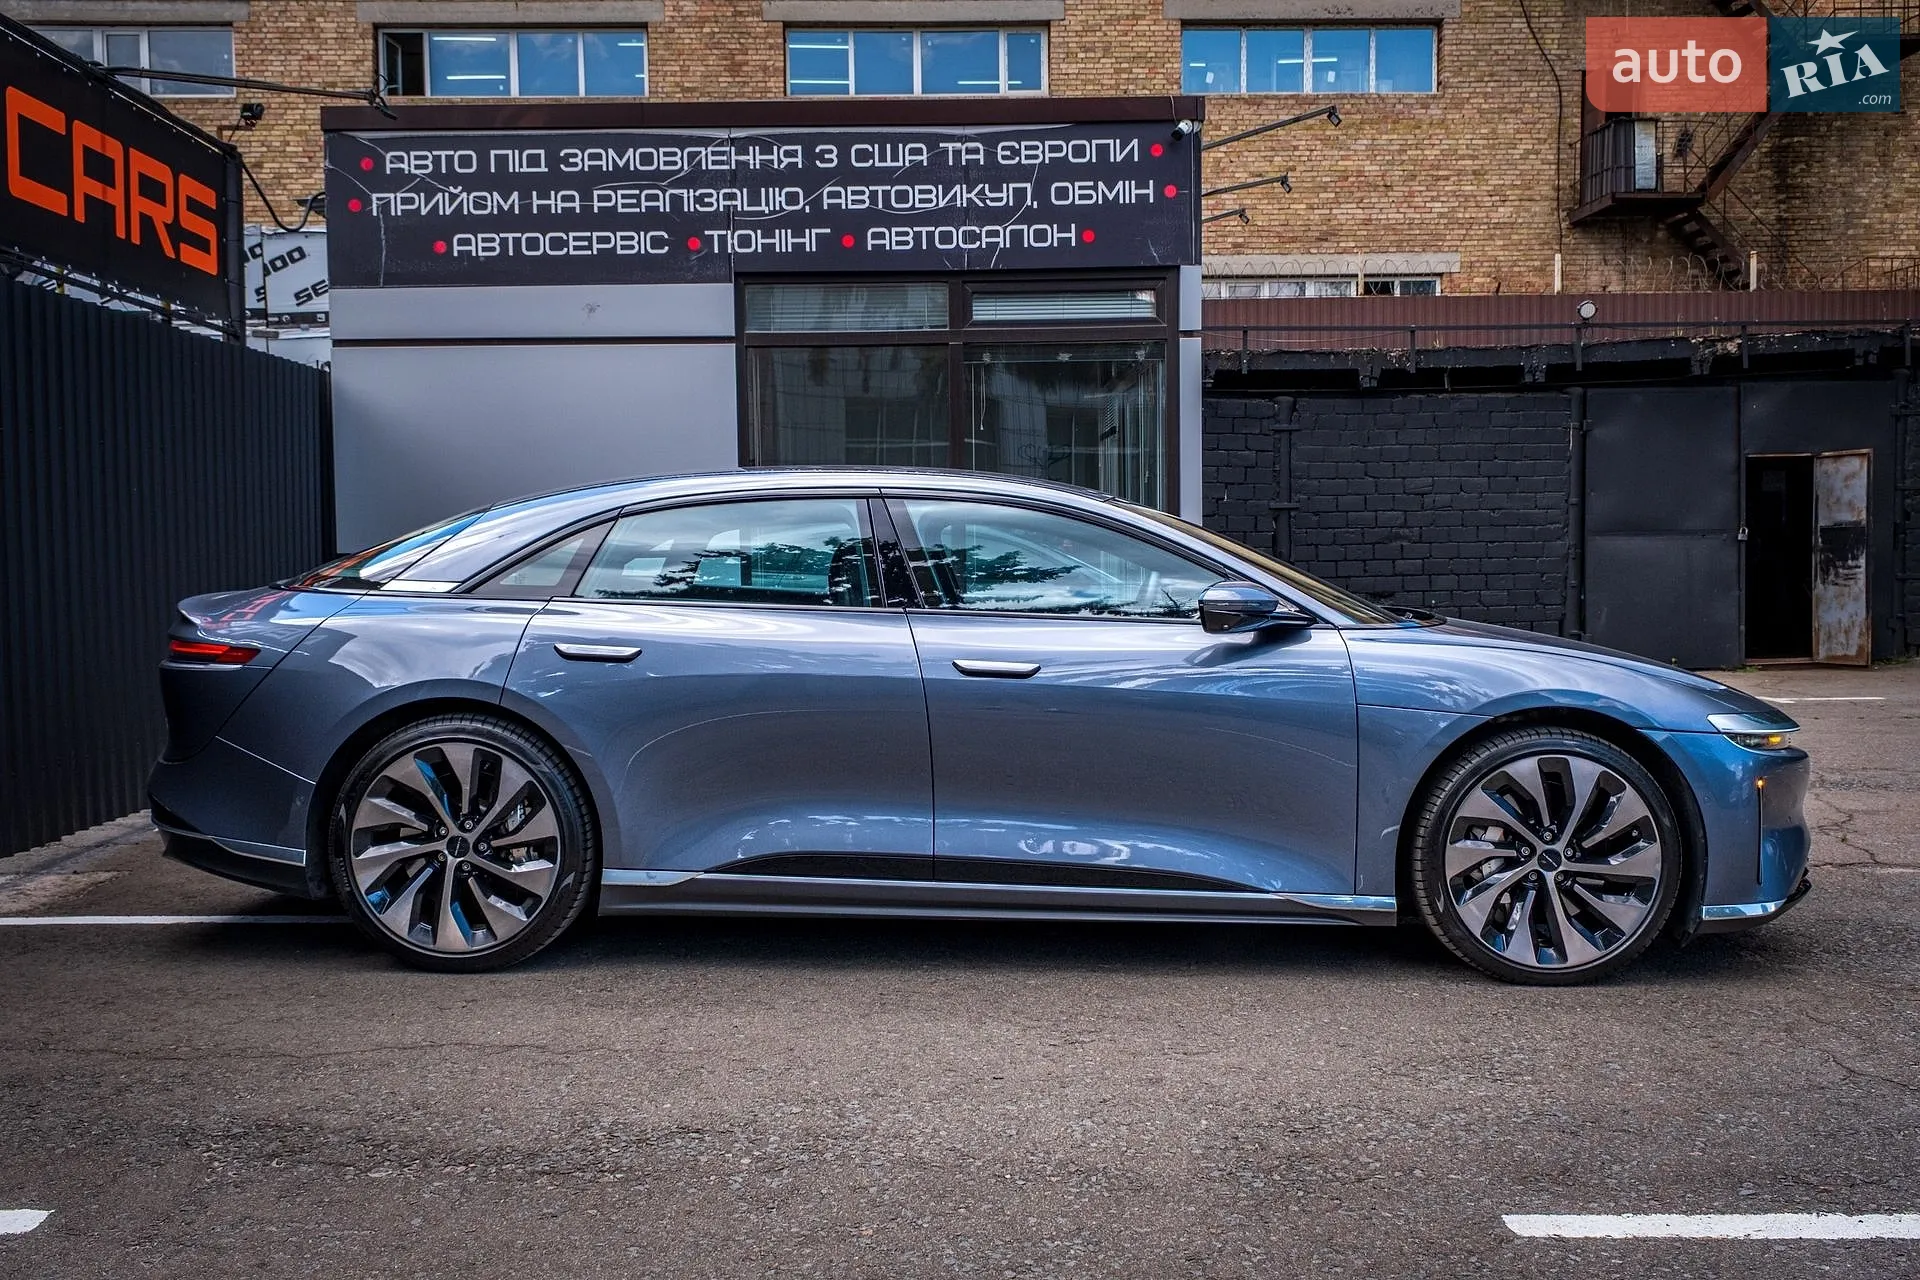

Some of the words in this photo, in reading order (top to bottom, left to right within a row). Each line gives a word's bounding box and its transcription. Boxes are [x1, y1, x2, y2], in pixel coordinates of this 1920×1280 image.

[386, 150, 477, 175] АВТО
[490, 148, 549, 173] ПІД
[559, 145, 803, 172] ЗАМОВЛЕННЯ
[851, 143, 928, 168] США
[940, 142, 985, 166] ТА
[997, 139, 1139, 165] ЄВРОПИ
[6, 86, 219, 277] CARS
[371, 186, 519, 217] ПРИЙОМ
[532, 190, 580, 215] НА
[593, 187, 810, 214] РЕАЛІЗАЦІЮ,
[823, 183, 1038, 210] АВТОВИКУП,
[1051, 180, 1154, 206] ОБМІН
[452, 231, 669, 257] АВТОСЕРВІС
[704, 227, 831, 253] ТЮНІНГ
[867, 224, 1076, 251] АВТОСАЛОН
